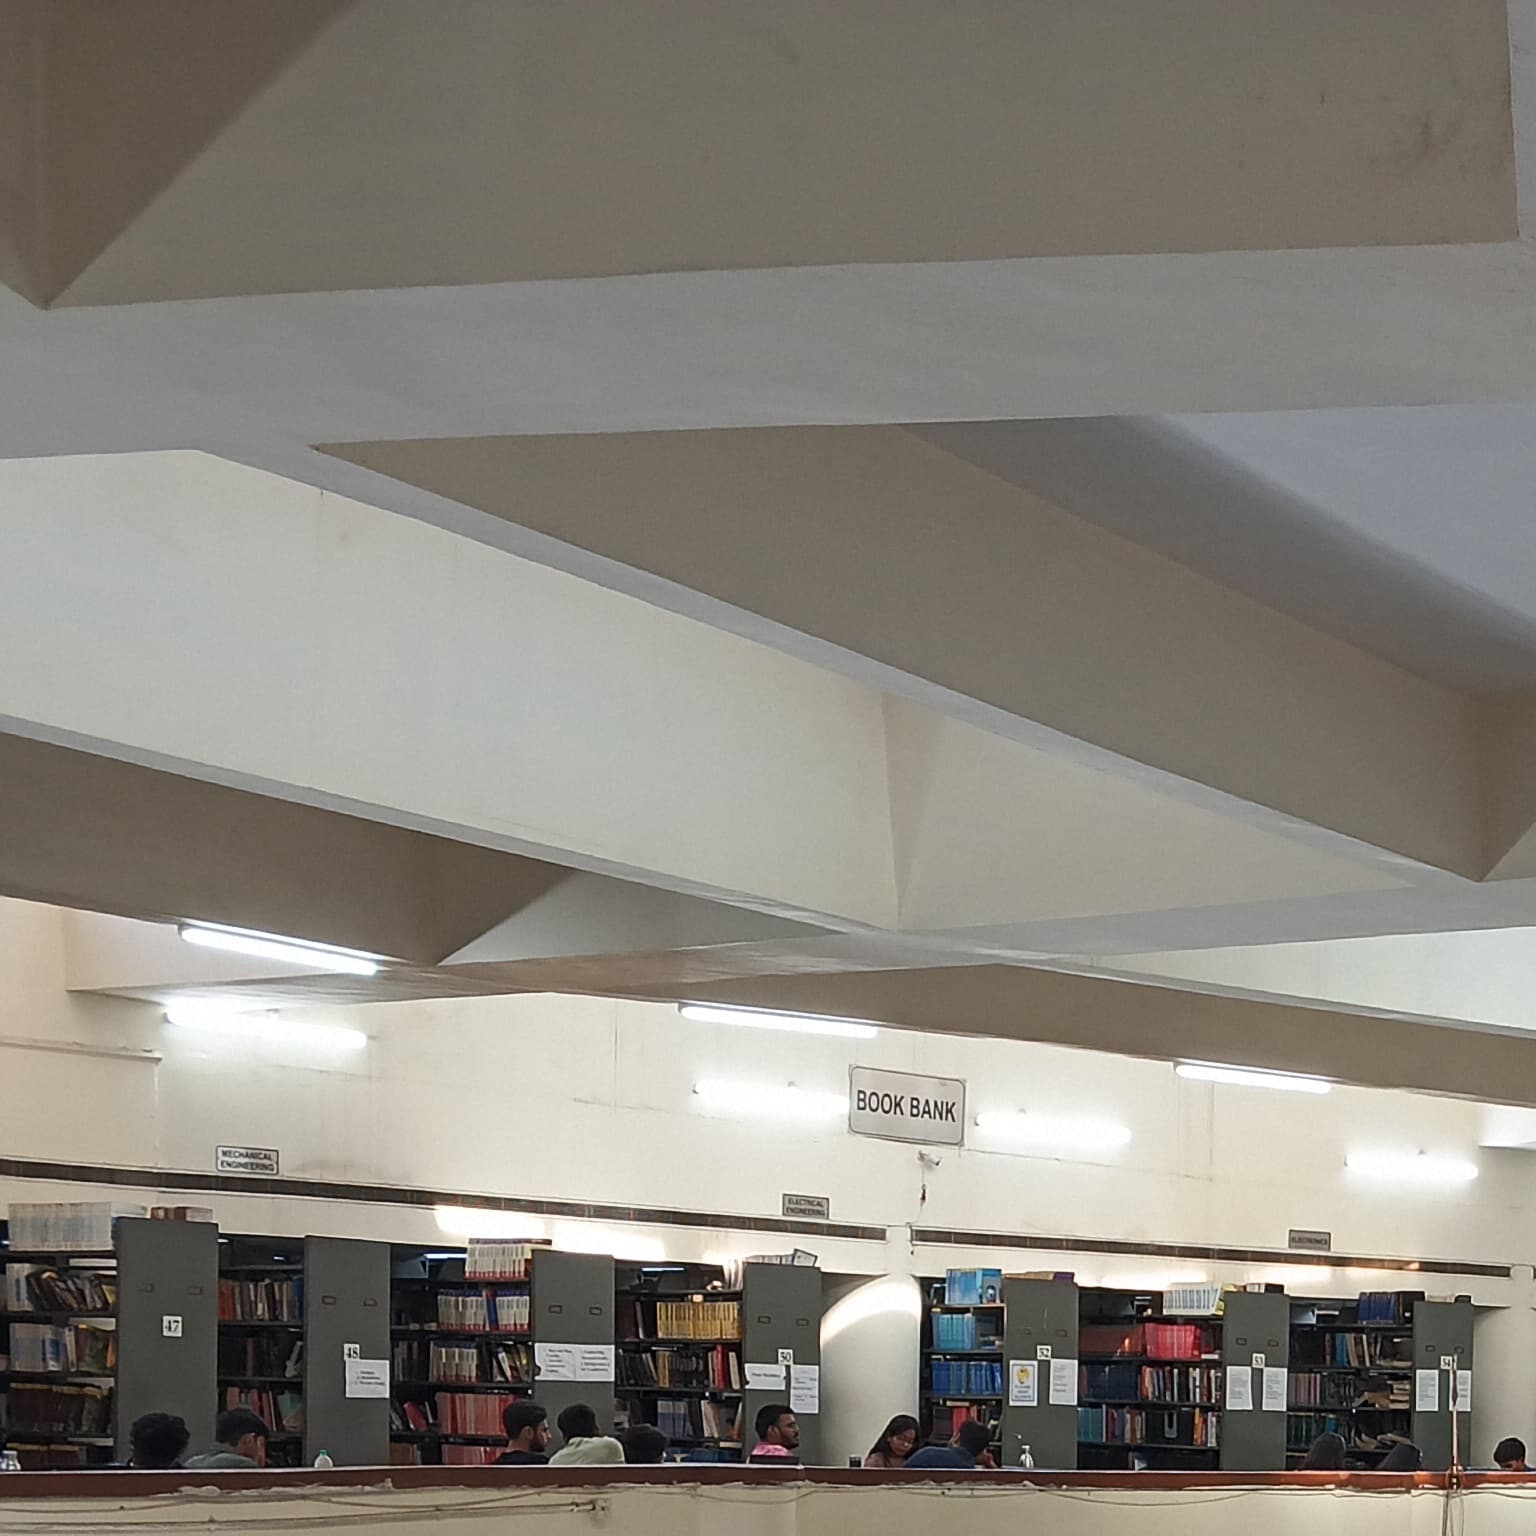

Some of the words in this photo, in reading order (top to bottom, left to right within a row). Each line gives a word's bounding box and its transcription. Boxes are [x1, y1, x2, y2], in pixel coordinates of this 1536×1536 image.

[856, 1089, 904, 1116] BOOK
[910, 1096, 956, 1123] BANK
[221, 1149, 272, 1161] MECHANICAL
[164, 1319, 180, 1332] 47
[780, 1351, 791, 1362] 50
